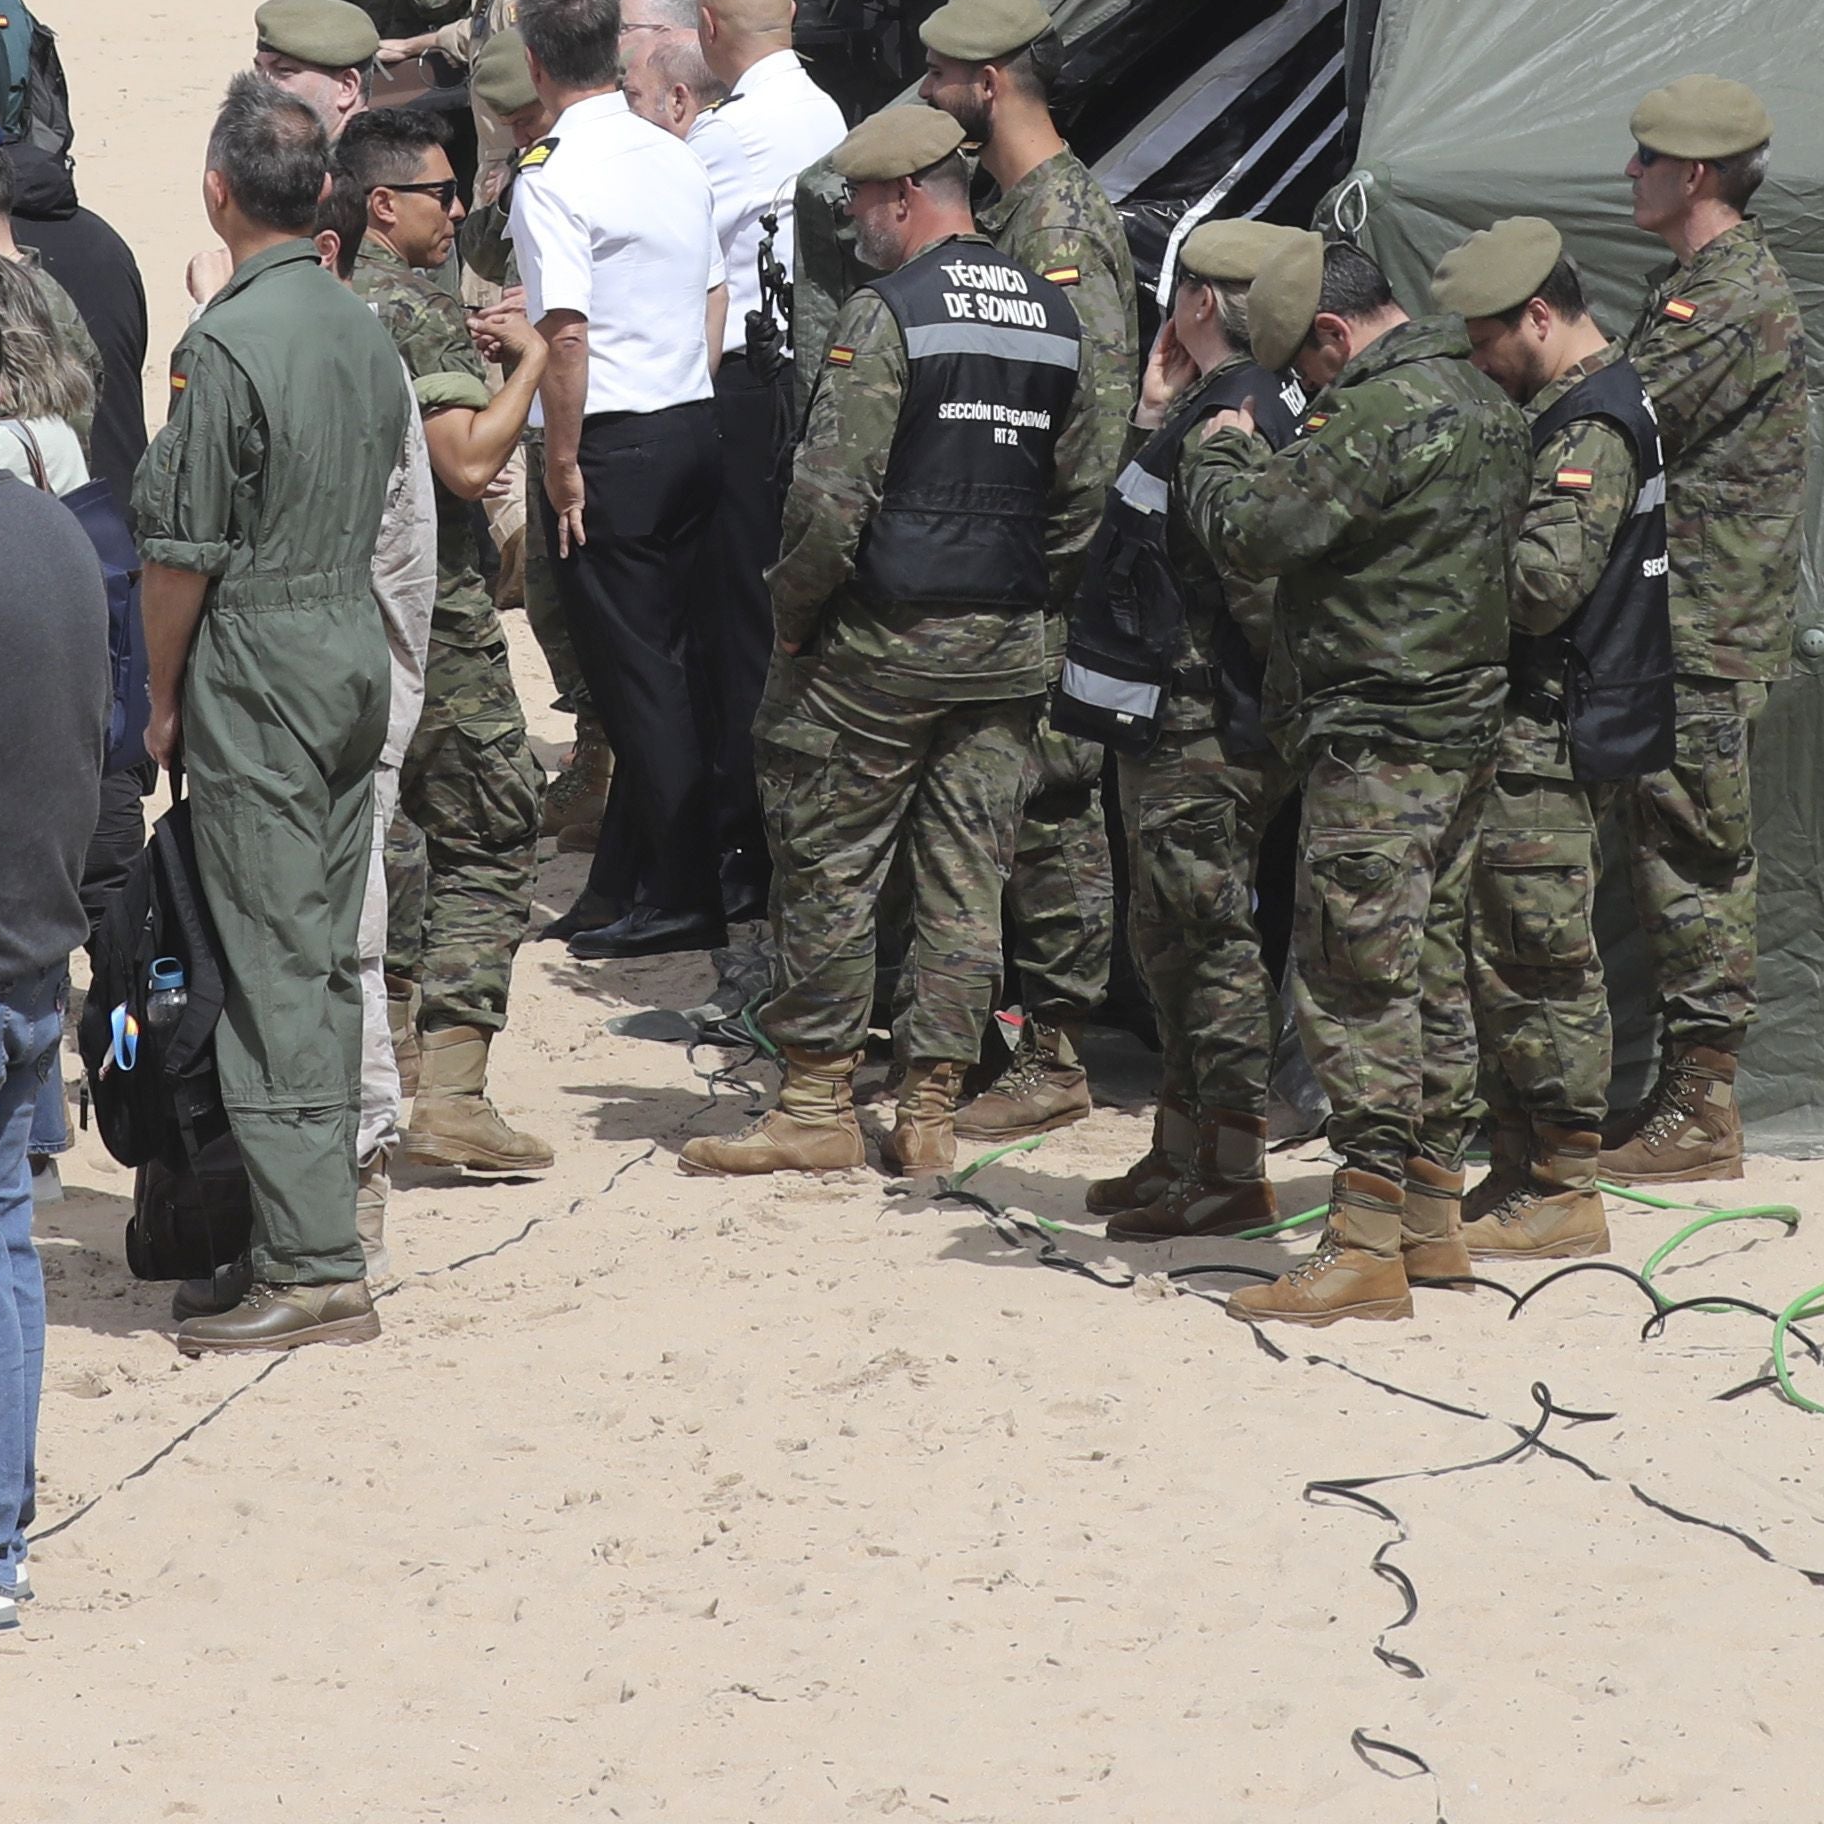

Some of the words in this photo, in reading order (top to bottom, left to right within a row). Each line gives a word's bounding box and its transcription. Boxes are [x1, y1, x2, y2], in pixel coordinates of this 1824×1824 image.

[940, 259, 1028, 294] TÉCNICO
[942, 293, 975, 318] DE
[975, 293, 1047, 328] SONIDO
[939, 400, 990, 420] SECCIÓN
[993, 404, 1006, 421] DE
[994, 428, 1006, 444] RT
